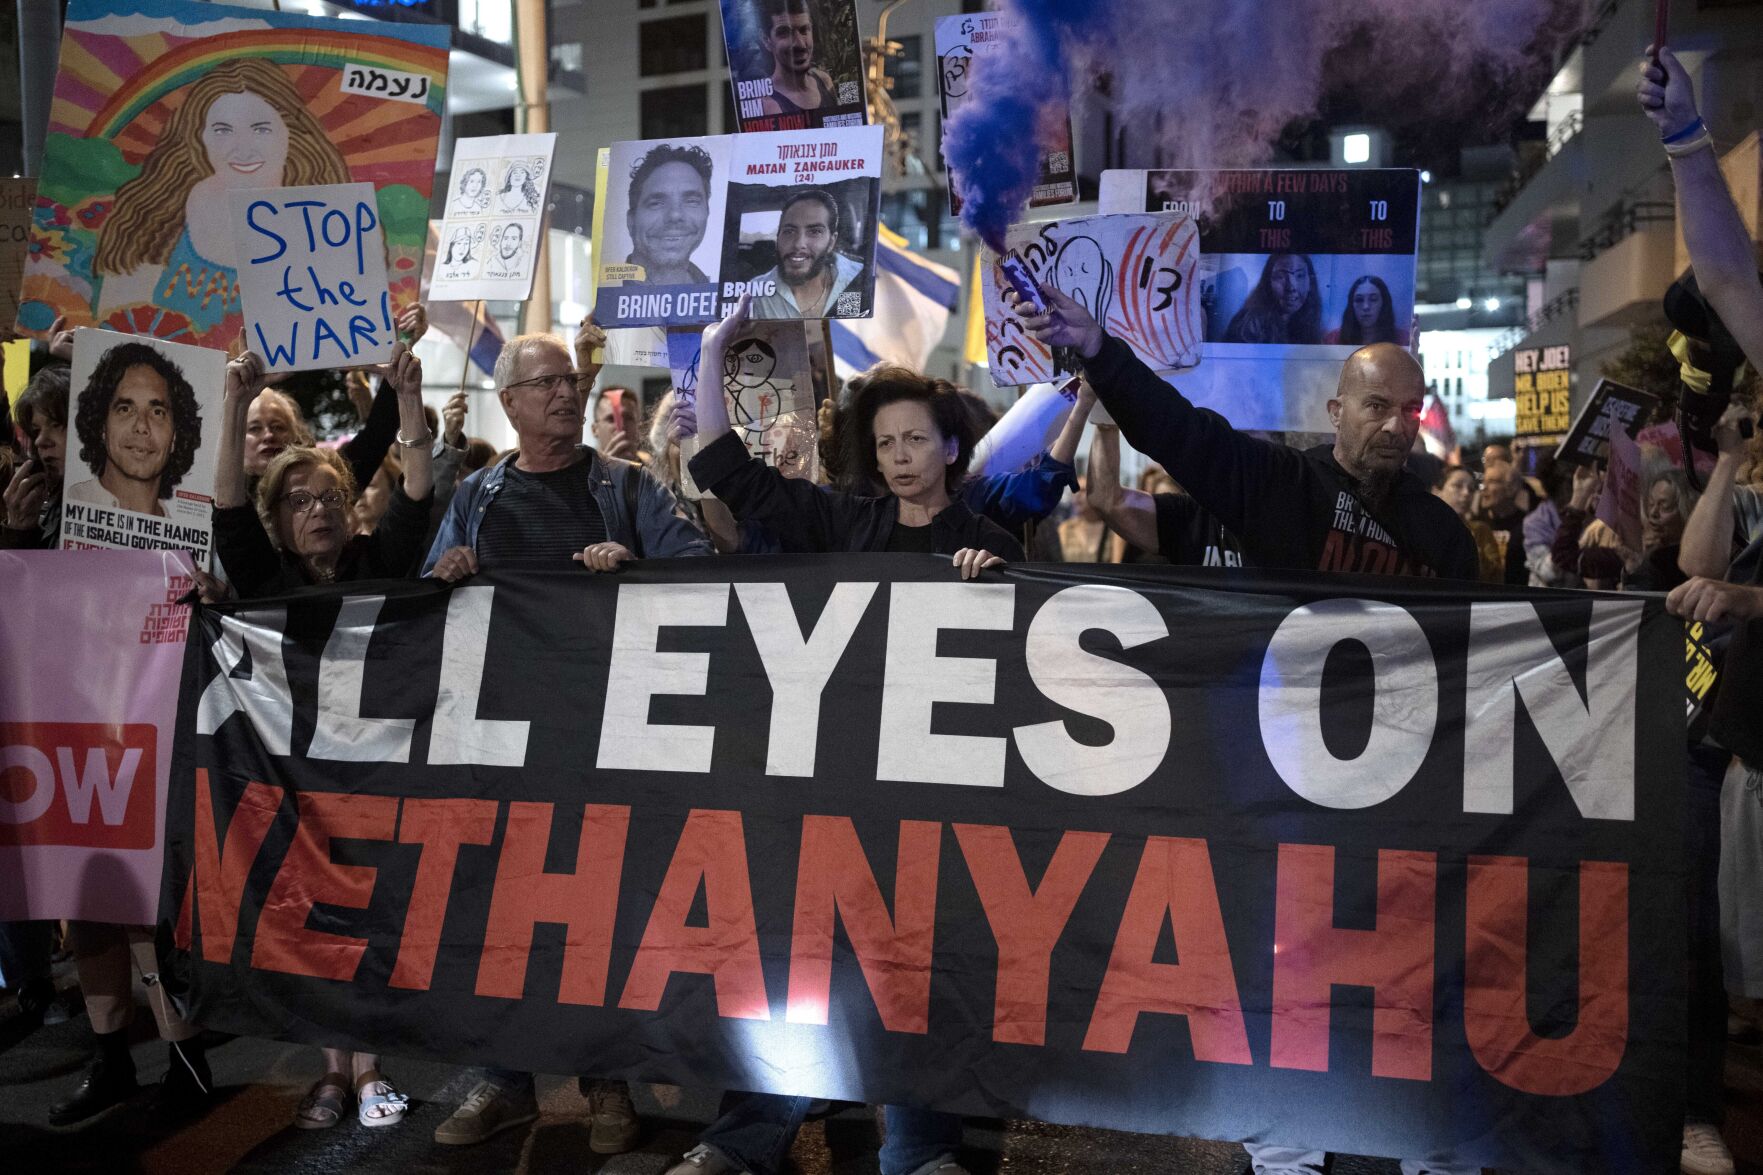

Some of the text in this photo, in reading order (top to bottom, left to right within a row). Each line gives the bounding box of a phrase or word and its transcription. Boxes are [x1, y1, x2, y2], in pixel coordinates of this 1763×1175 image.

[970, 31, 999, 43] ABRAHA
[348, 69, 427, 98] נעמה
[738, 78, 773, 100] BRING
[740, 99, 763, 119] HIM
[820, 143, 837, 159] מתן
[746, 159, 865, 175] MATAN ZANGAUKER
[795, 173, 814, 183] (24)
[1263, 173, 1273, 193] A
[1277, 173, 1307, 193] FEW
[1309, 173, 1348, 193] DAYS
[1268, 201, 1285, 221] TO
[1369, 200, 1388, 220] TO
[246, 201, 377, 275] STOP
[1260, 228, 1291, 248] THIS
[1361, 228, 1393, 248] THIS
[278, 266, 367, 312] the
[723, 280, 776, 297] BRING
[617, 294, 672, 319] BRING
[255, 291, 394, 367] WAR!
[1515, 349, 1539, 372] HEY
[1516, 390, 1569, 415] HELP US
[64, 521, 73, 535] OF
[74, 523, 85, 538] THE
[87, 526, 129, 547] ISRAELI
[66, 503, 209, 546] MY LIFE IS IN THE HANDS
[196, 582, 1644, 821] ALL EYES ON
[174, 768, 1629, 1096] NETHANYAHU
